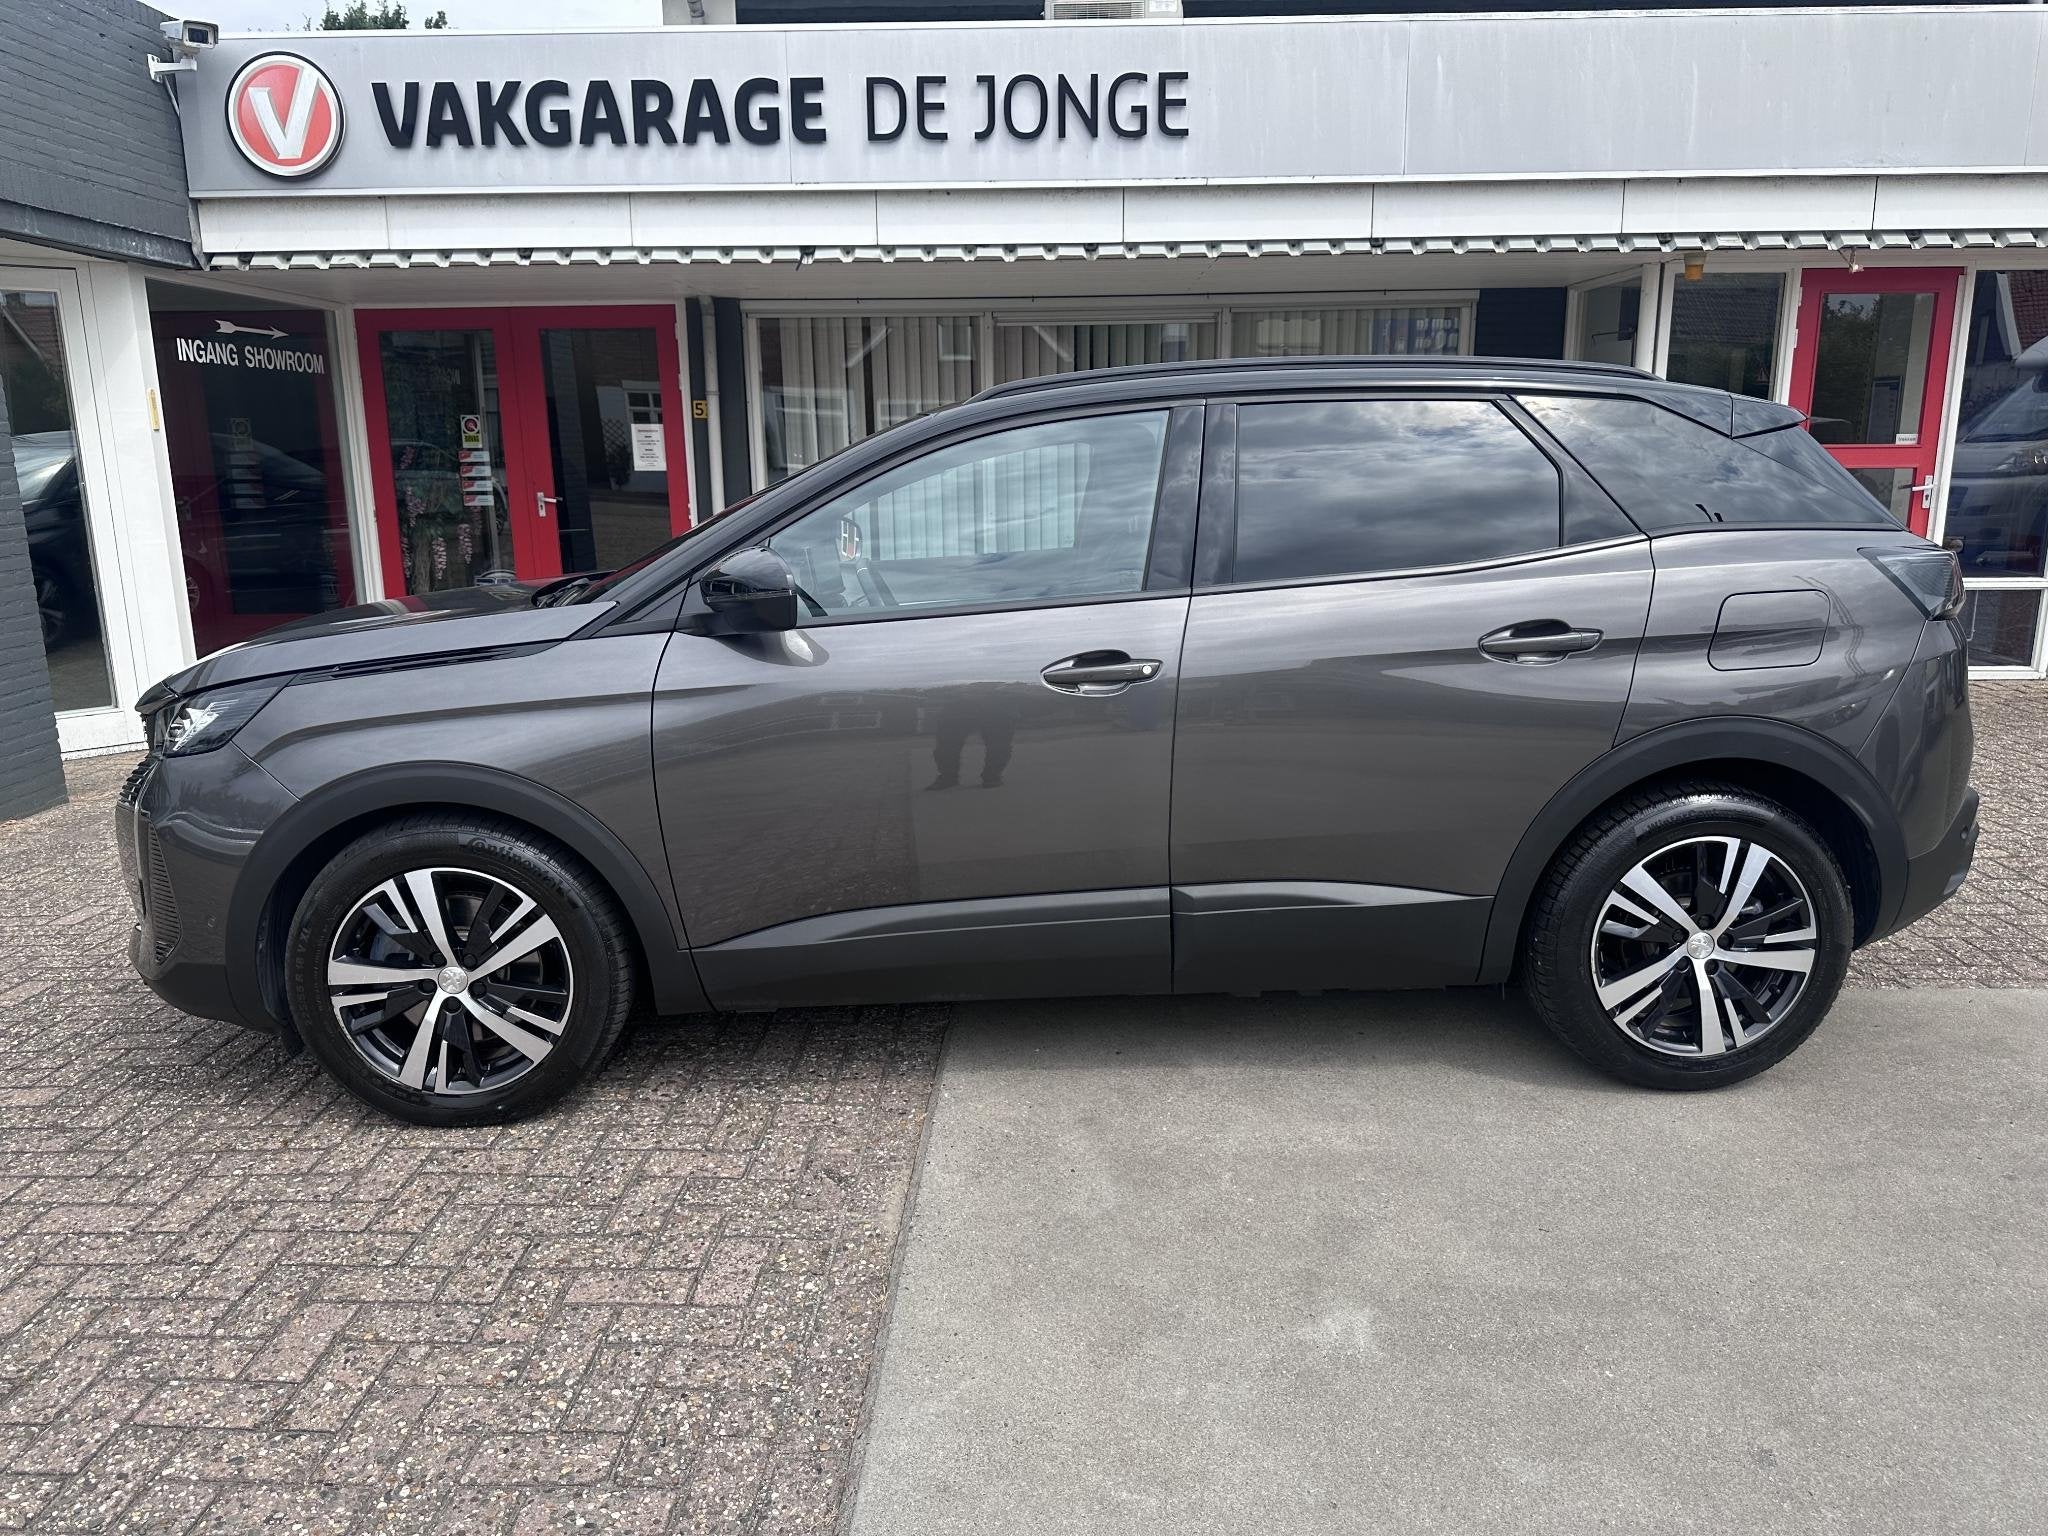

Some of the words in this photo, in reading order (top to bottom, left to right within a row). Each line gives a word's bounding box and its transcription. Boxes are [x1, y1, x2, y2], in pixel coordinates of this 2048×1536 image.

[372, 78, 827, 149] VAKGARAGE
[867, 76, 948, 142] DE
[974, 72, 1189, 141] JONGE
[176, 337, 239, 366] INGANG
[245, 345, 325, 374] SHOWROOM
